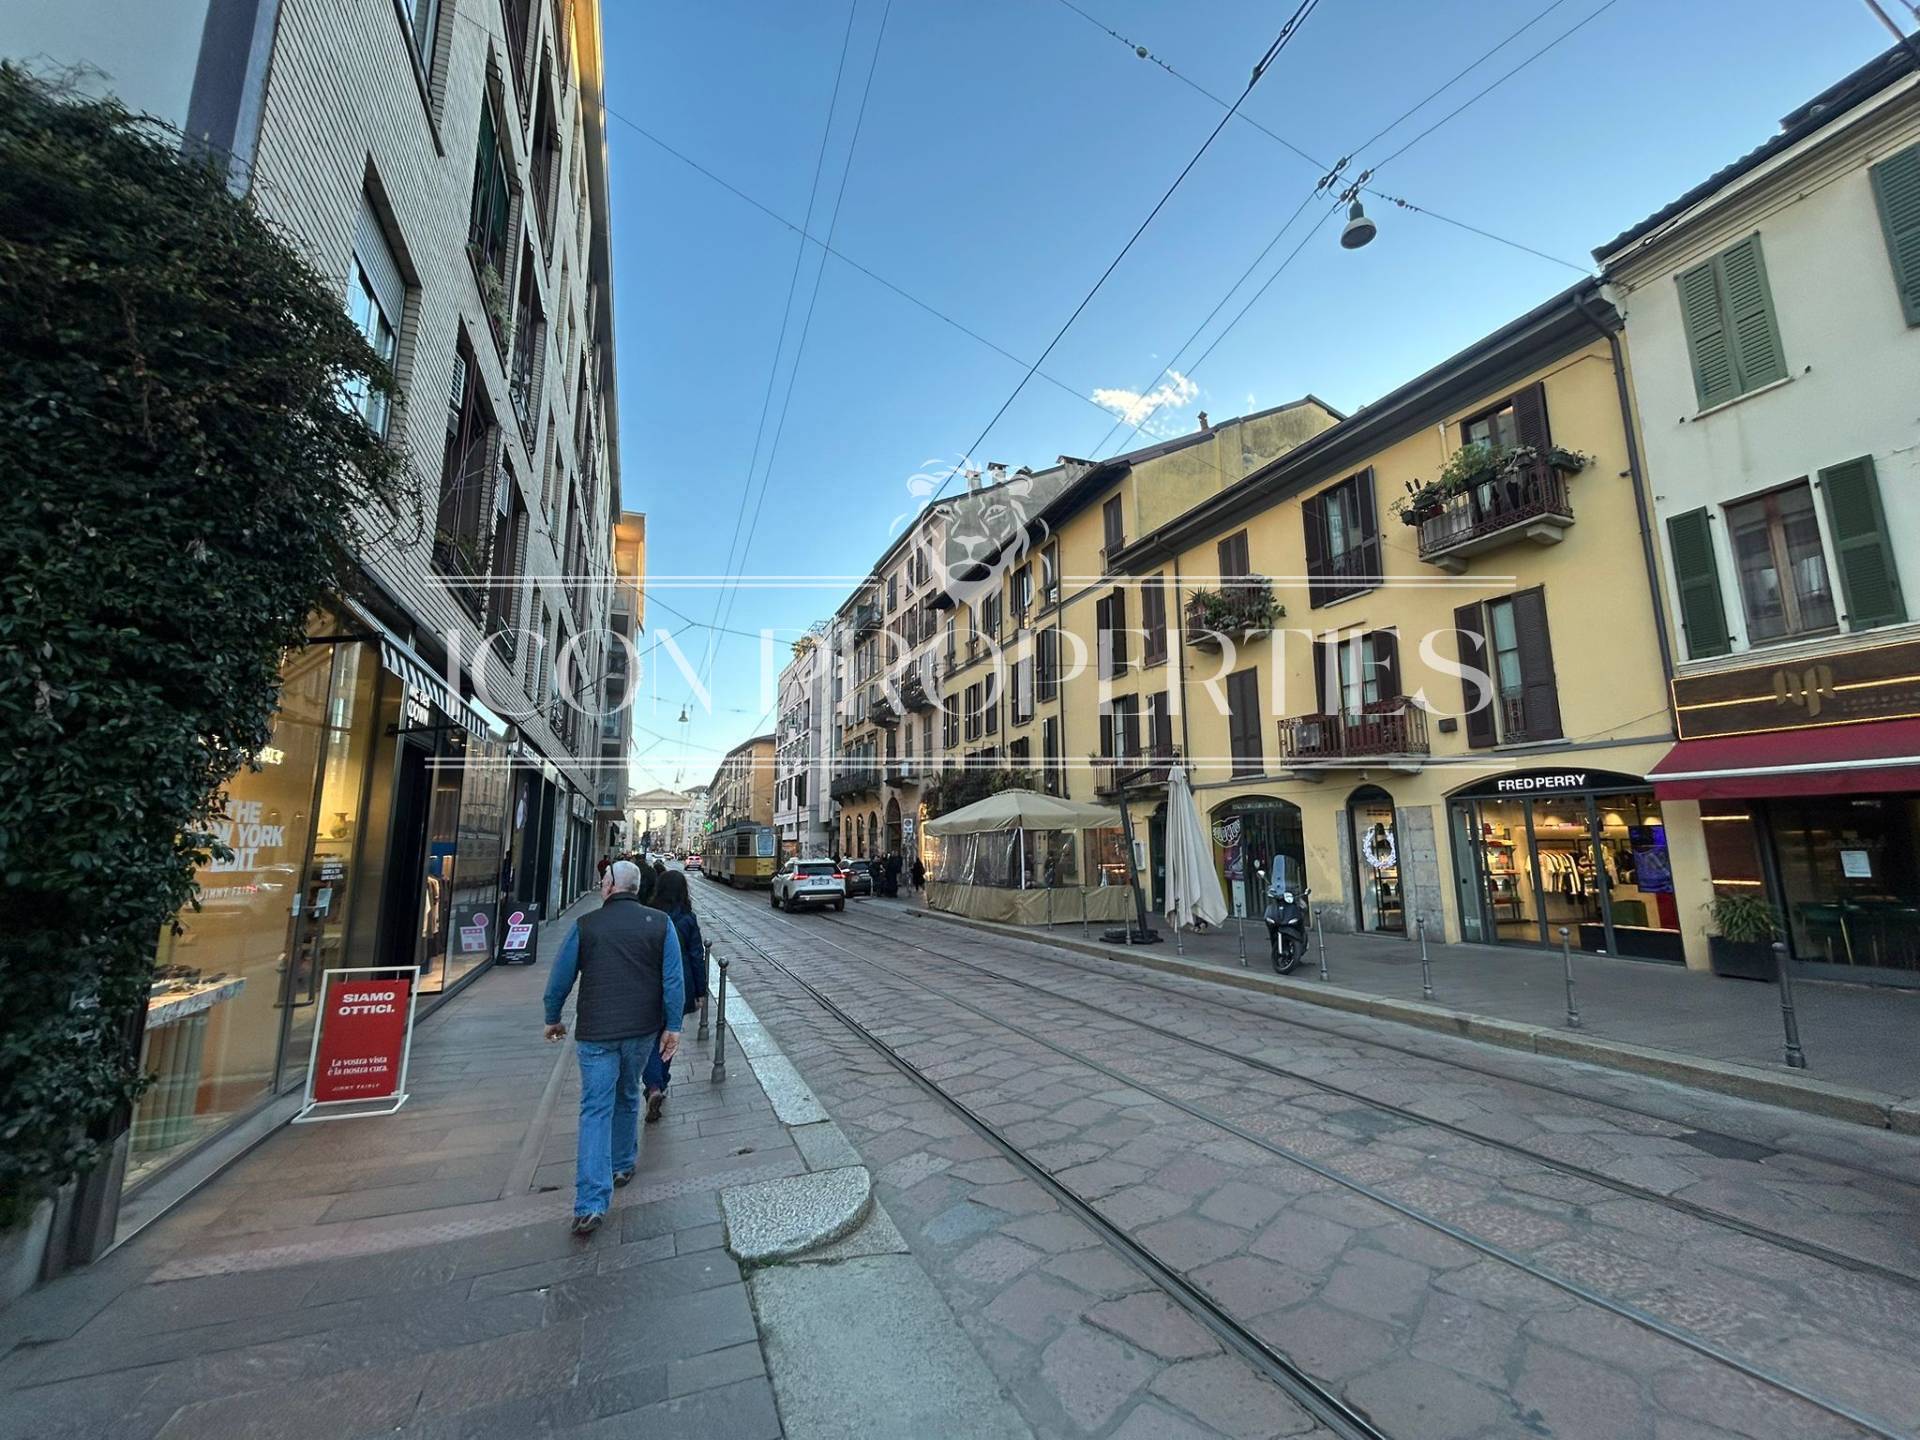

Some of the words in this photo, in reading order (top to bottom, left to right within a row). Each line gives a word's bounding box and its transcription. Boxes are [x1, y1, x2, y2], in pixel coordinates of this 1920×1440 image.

[1498, 778, 1535, 791] FRED
[1536, 774, 1586, 788] PERRY
[225, 801, 263, 824] THE
[238, 824, 285, 847] YORK
[342, 992, 395, 1003] SIAMO
[338, 1004, 395, 1015] OTTICI.
[331, 1059, 342, 1067] La
[343, 1057, 367, 1066] vostra
[369, 1056, 388, 1064] vista
[334, 1067, 342, 1076] la
[343, 1066, 368, 1075] nostra
